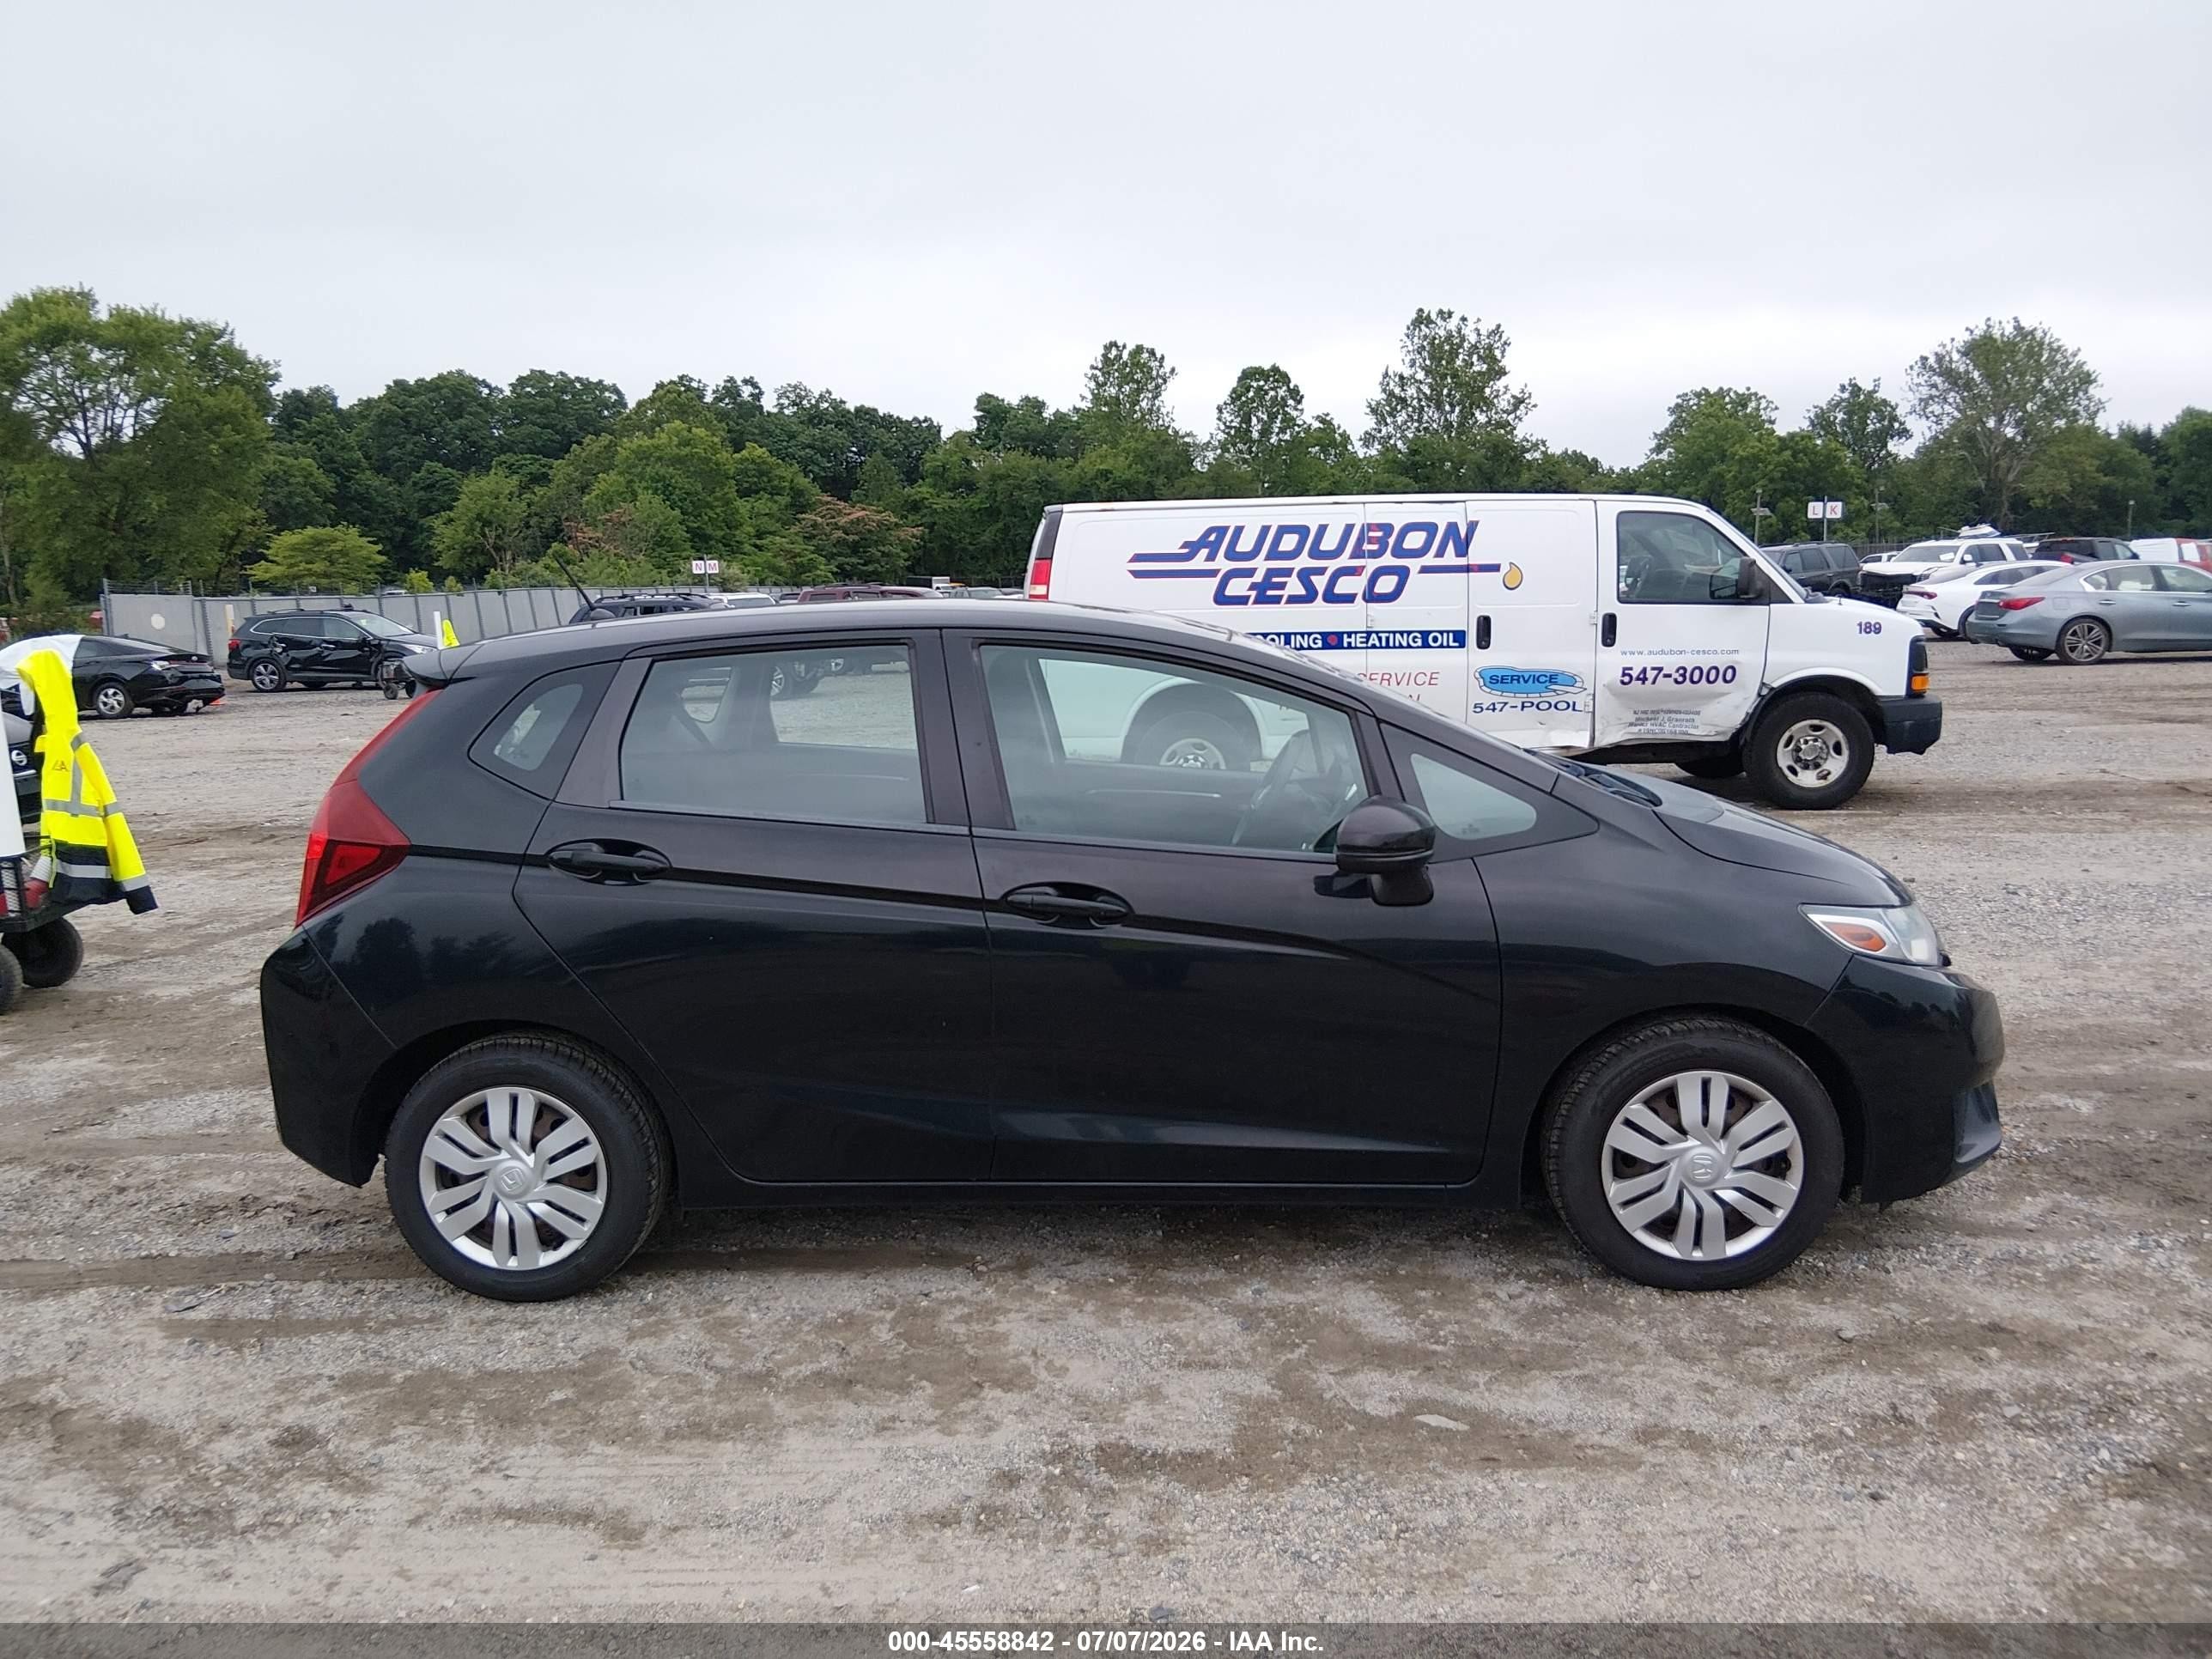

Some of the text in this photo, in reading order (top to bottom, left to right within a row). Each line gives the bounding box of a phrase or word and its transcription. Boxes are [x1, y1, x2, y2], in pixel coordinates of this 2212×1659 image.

[1812, 505, 1819, 515] L
[1830, 505, 1838, 515] K
[1178, 520, 1480, 563] AUDUBON
[695, 562, 702, 571] N
[708, 562, 717, 571] M
[1212, 564, 1411, 607] CESCO
[1856, 621, 1882, 635] 189
[1343, 632, 1423, 647] HEATING
[1428, 632, 1460, 647] OIL
[1620, 648, 1740, 657] www.audubon-cesco.com
[1489, 674, 1559, 684] SERVICE
[1620, 665, 1737, 685] 547-3000
[1473, 700, 1583, 714] 547-POOL
